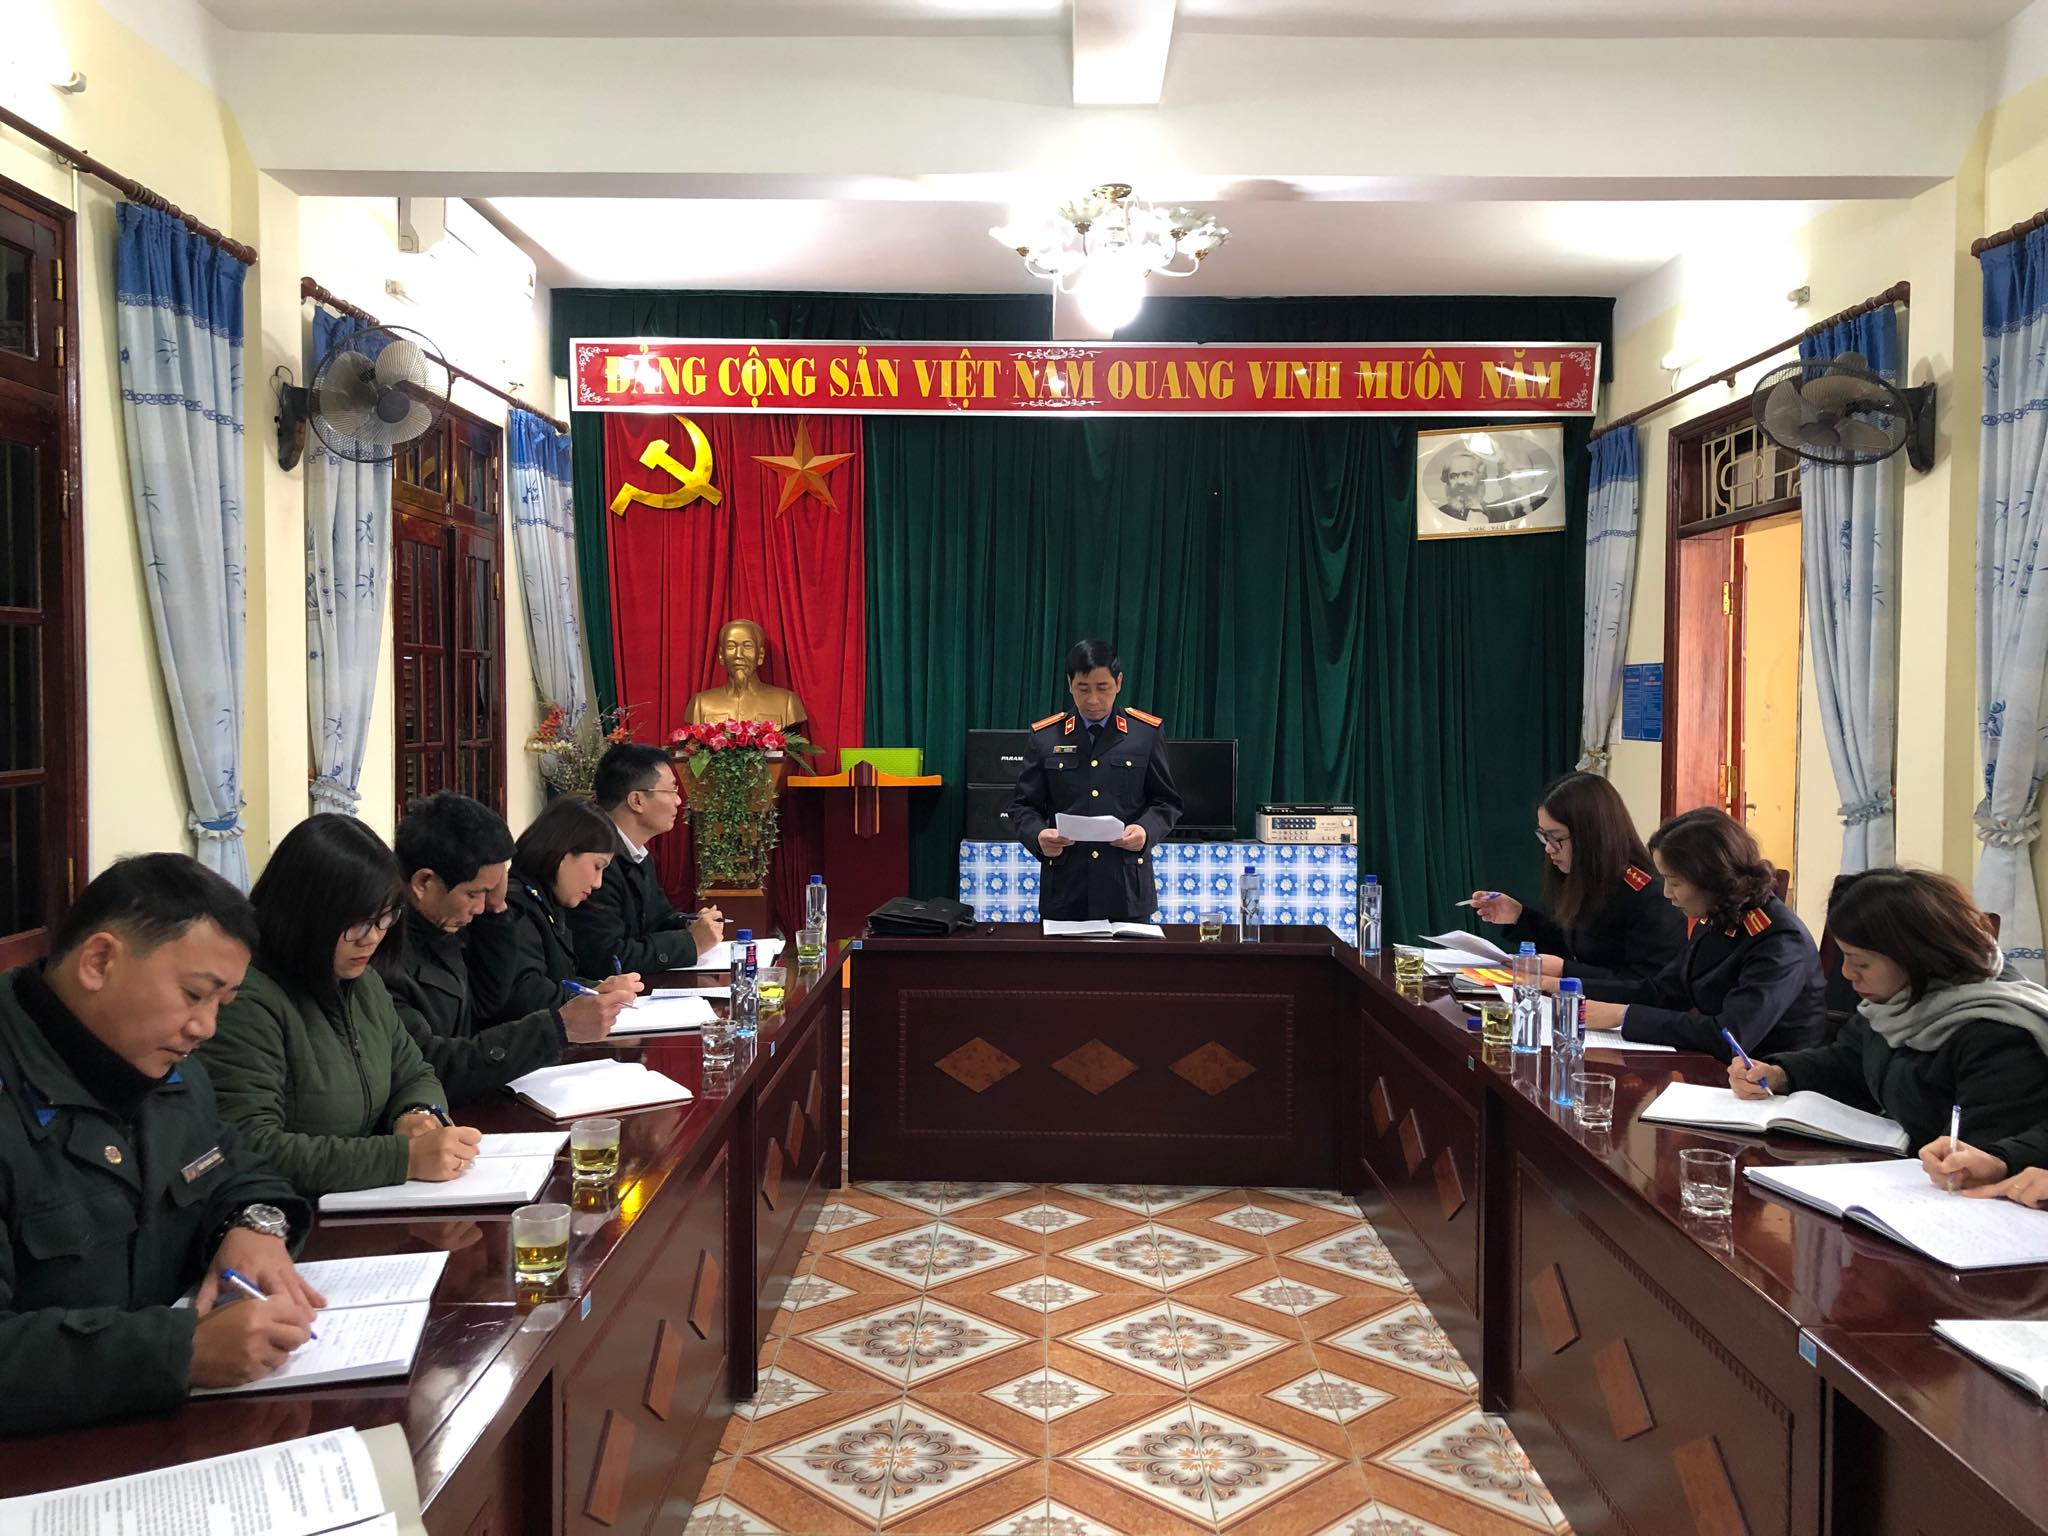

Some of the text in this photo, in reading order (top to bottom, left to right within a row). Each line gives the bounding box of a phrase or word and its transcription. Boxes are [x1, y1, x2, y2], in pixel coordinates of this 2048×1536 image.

[605, 344, 1564, 409] ĐẢNG CỘNG SẢN VIỆT NAM QUANG VINH MUÔN NĂM
